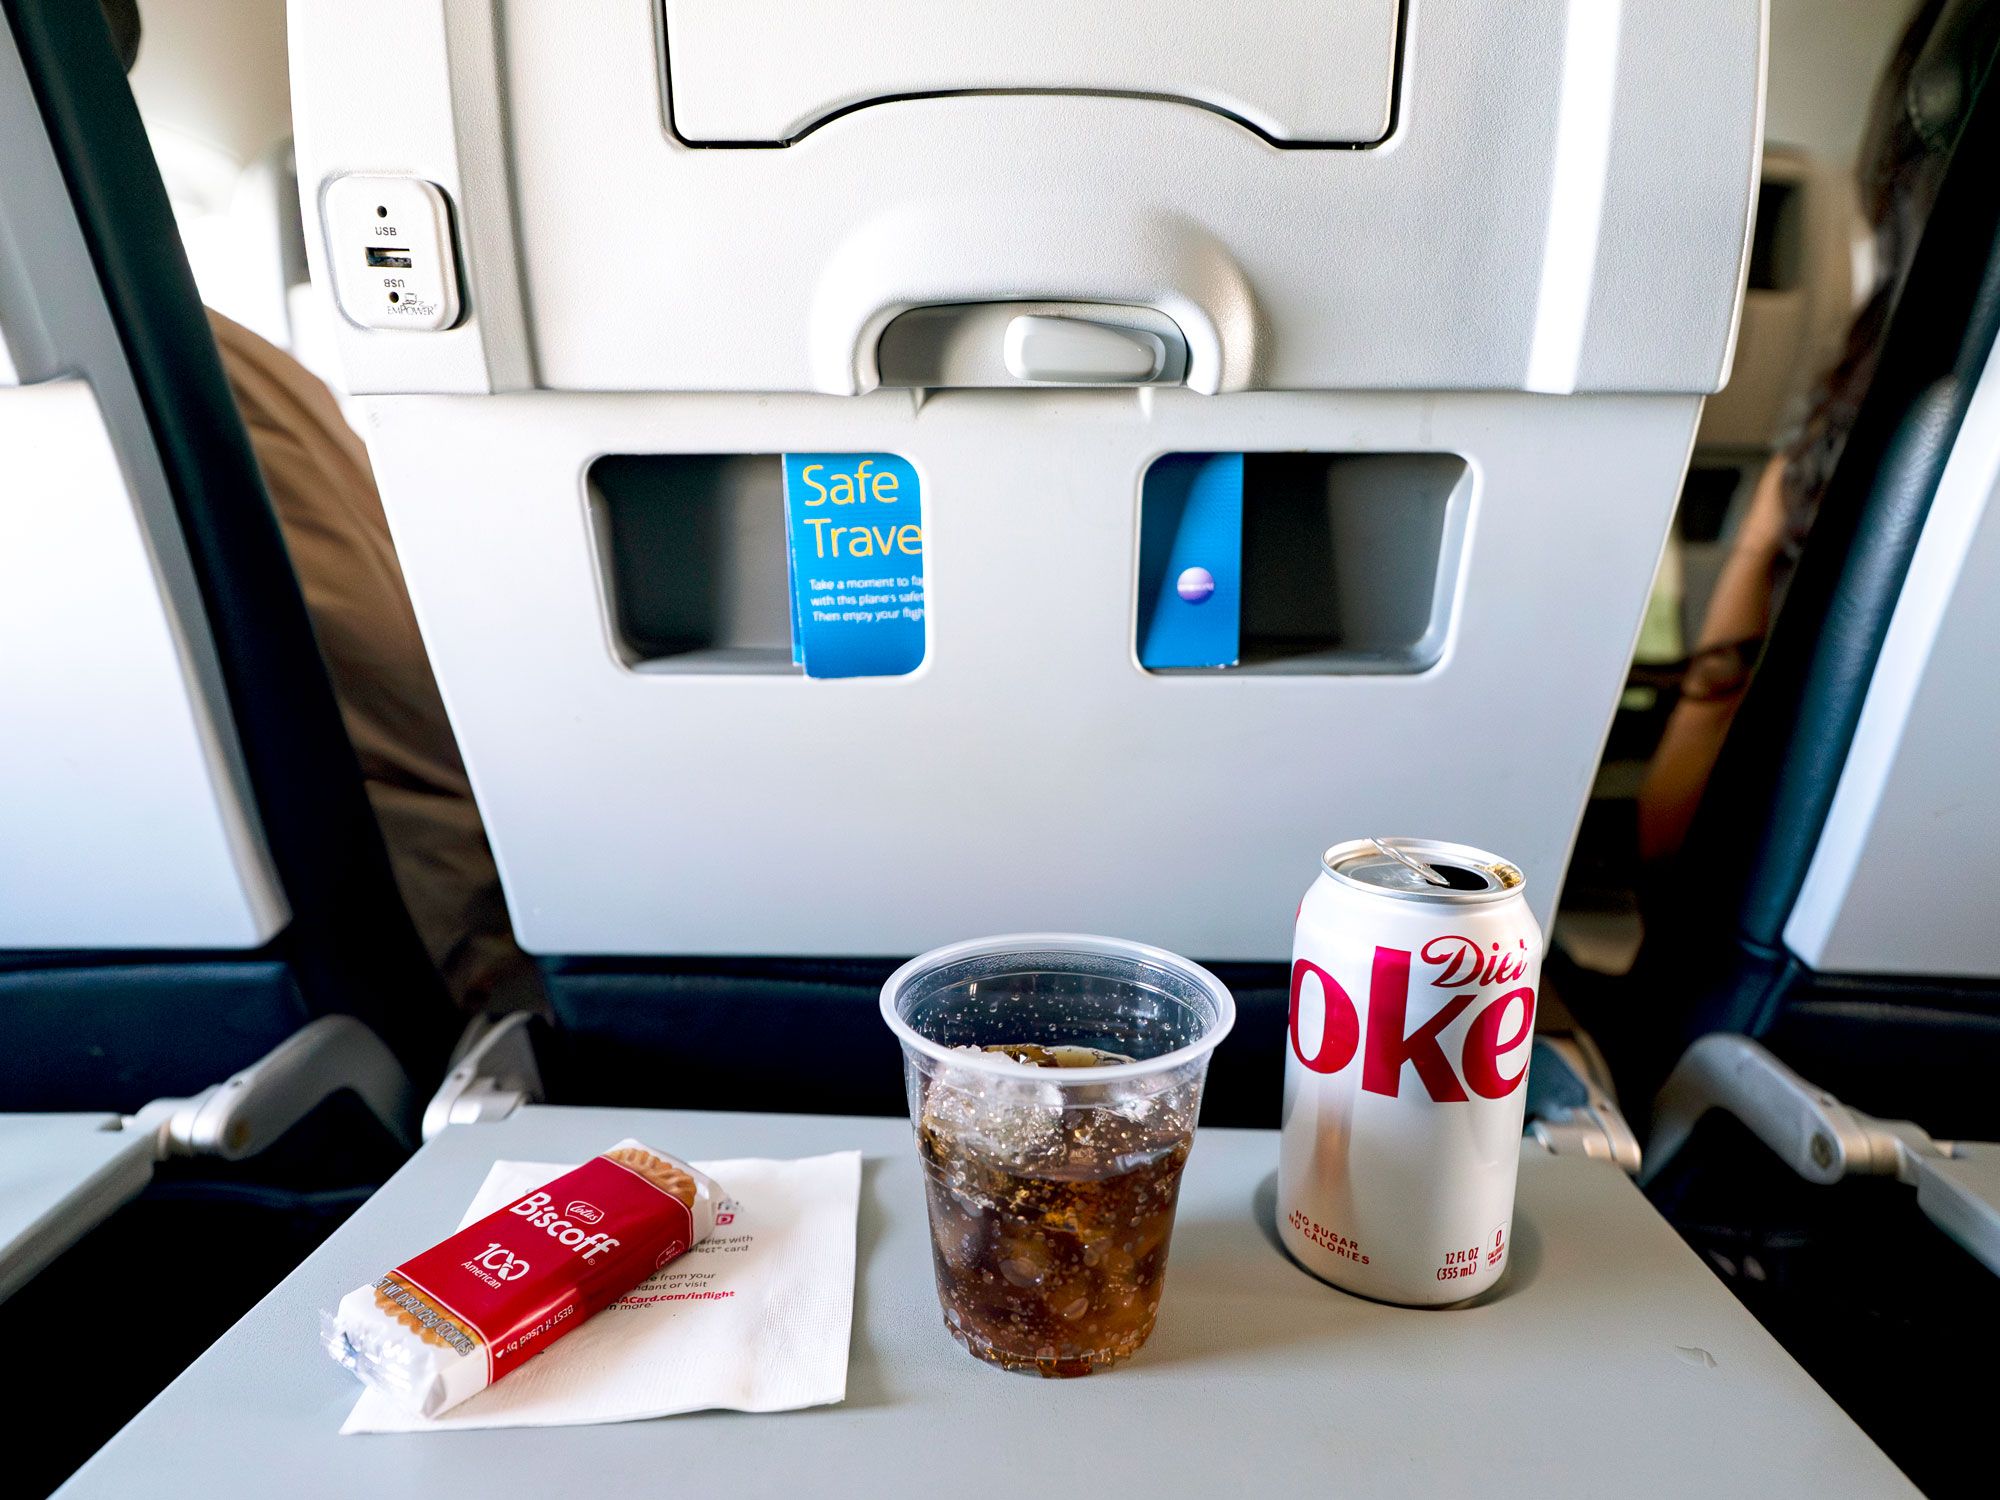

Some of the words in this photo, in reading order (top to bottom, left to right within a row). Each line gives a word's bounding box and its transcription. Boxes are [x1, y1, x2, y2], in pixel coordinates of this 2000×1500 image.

[375, 227, 397, 236] USB
[384, 279, 405, 288] USB
[802, 460, 899, 506] Safe
[803, 518, 922, 558] Trave
[809, 579, 835, 590] Take
[836, 580, 845, 590] a
[846, 578, 894, 589] moment
[896, 577, 909, 587] to
[911, 575, 923, 587] fa
[810, 595, 835, 606] with
[837, 594, 856, 605] this
[813, 609, 841, 621] Then
[843, 610, 873, 624] enjoy
[875, 610, 900, 622] your
[1421, 935, 1528, 988] Diet
[1289, 945, 1536, 1103] oke
[569, 1204, 598, 1221] Lotus
[509, 1191, 620, 1260] Biscoff
[1296, 1210, 1309, 1226] NO
[1313, 1223, 1358, 1251] SUGAR
[729, 1235, 753, 1244] with
[1289, 1213, 1300, 1229] NO
[1304, 1228, 1370, 1265] CALORIES
[1496, 1230, 1502, 1247] 0
[724, 1244, 749, 1253] card
[1446, 1253, 1455, 1265] 12
[1457, 1250, 1466, 1263] FL
[1468, 1247, 1479, 1261] OZ
[473, 1242, 530, 1281] 100
[461, 1261, 502, 1290] American
[660, 1273, 687, 1282] from
[690, 1272, 716, 1283] your
[1437, 1267, 1458, 1281] (355
[1460, 1261, 1477, 1277] mL)
[684, 1280, 707, 1288] visit
[553, 1304, 574, 1325] BEST
[620, 1301, 654, 1311] more.
[544, 1318, 552, 1331] if
[435, 1320, 476, 1357] COOKIES
[520, 1324, 544, 1347] Used
[505, 1341, 518, 1353] by
